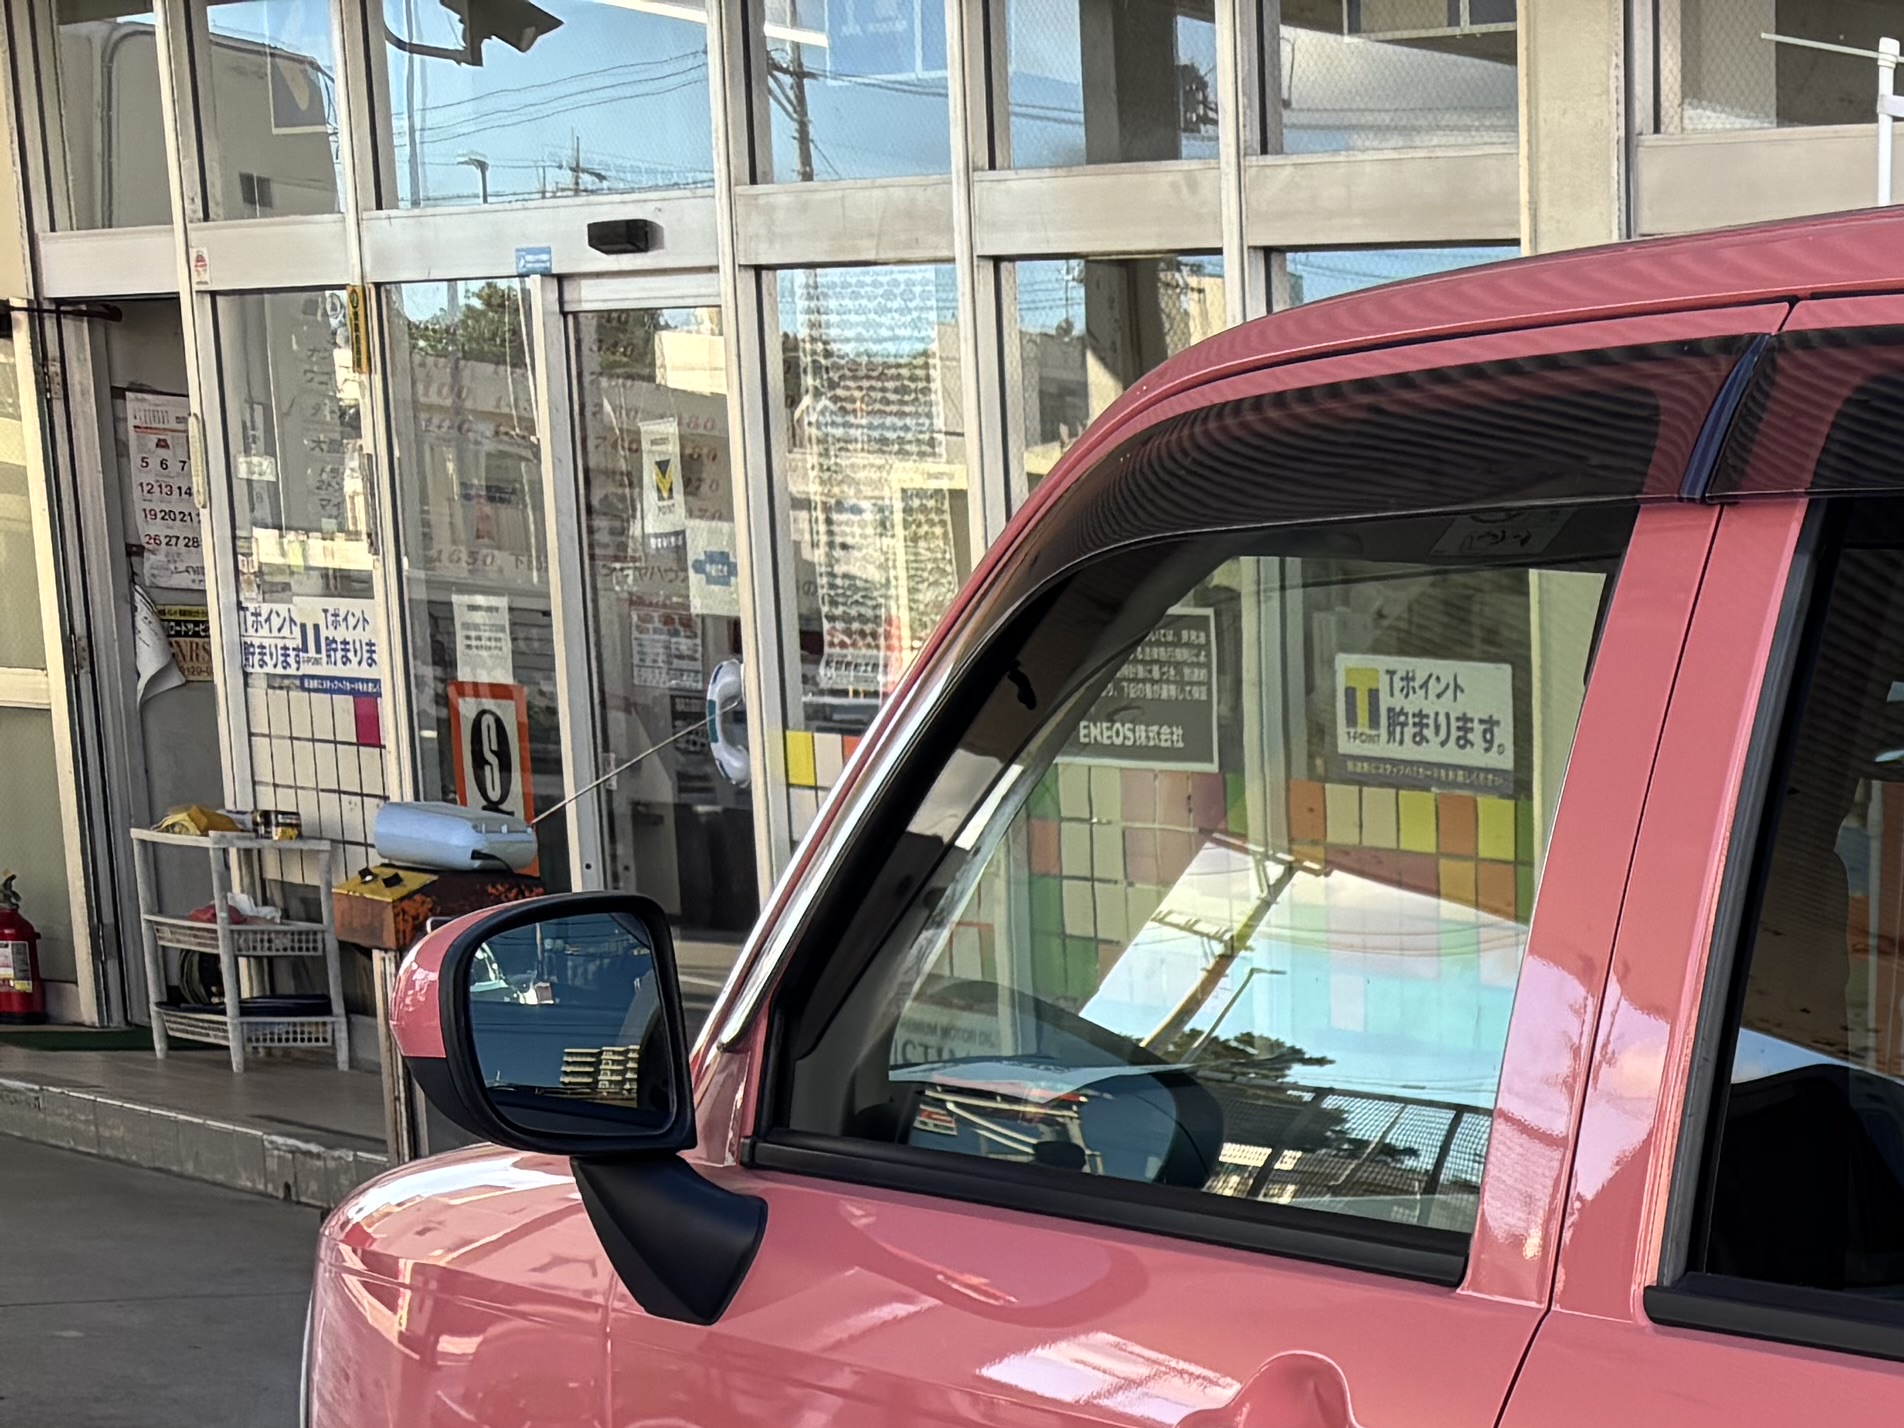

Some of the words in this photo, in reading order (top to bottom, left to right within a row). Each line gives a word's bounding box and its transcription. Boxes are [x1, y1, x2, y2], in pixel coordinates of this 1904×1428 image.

[159, 458, 169, 471] 6
[240, 605, 297, 635] Tポイント
[322, 608, 369, 632] Tポイント
[325, 636, 377, 668] 貯まりま
[1385, 668, 1465, 703] Tポイント
[1079, 720, 1184, 748] ENEOS株式会社
[1386, 706, 1506, 756] 貯まります。
